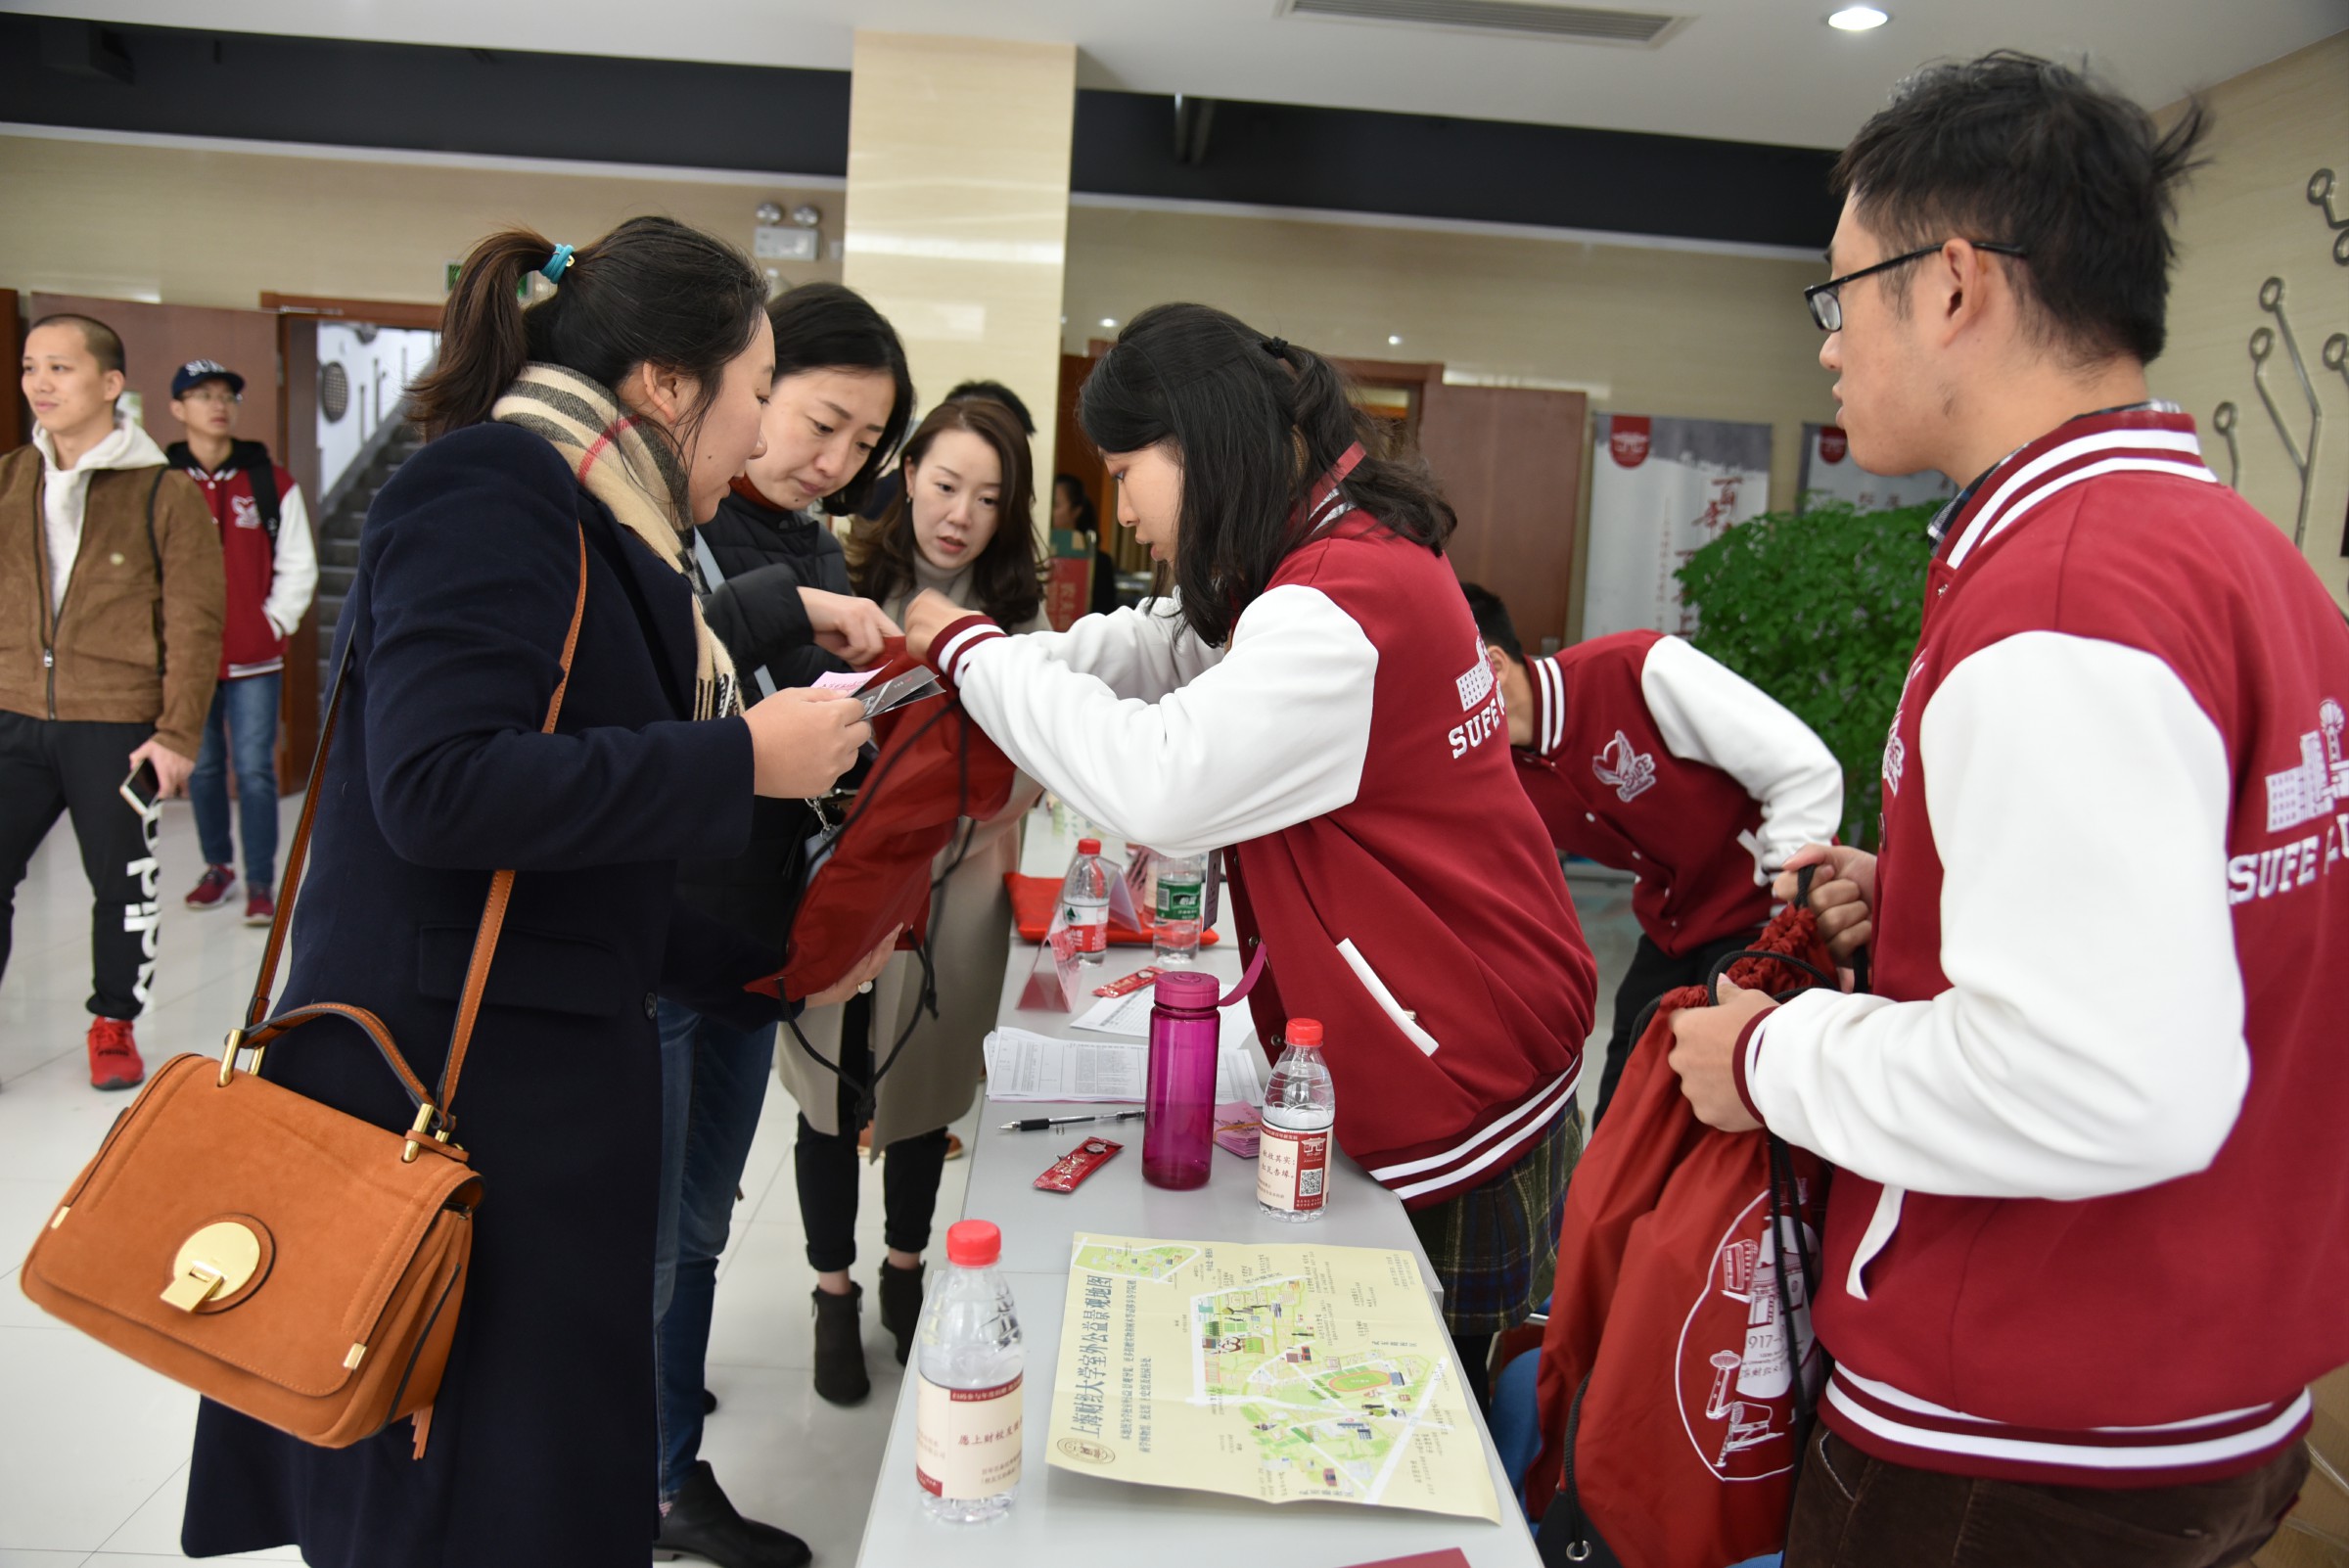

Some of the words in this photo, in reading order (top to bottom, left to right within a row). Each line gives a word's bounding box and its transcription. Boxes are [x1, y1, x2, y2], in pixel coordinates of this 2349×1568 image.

[1449, 698, 1500, 760] SUFE
[2228, 835, 2320, 905] SUFE
[1070, 1273, 1114, 1440] 上海财经大学室外公益景观地图
